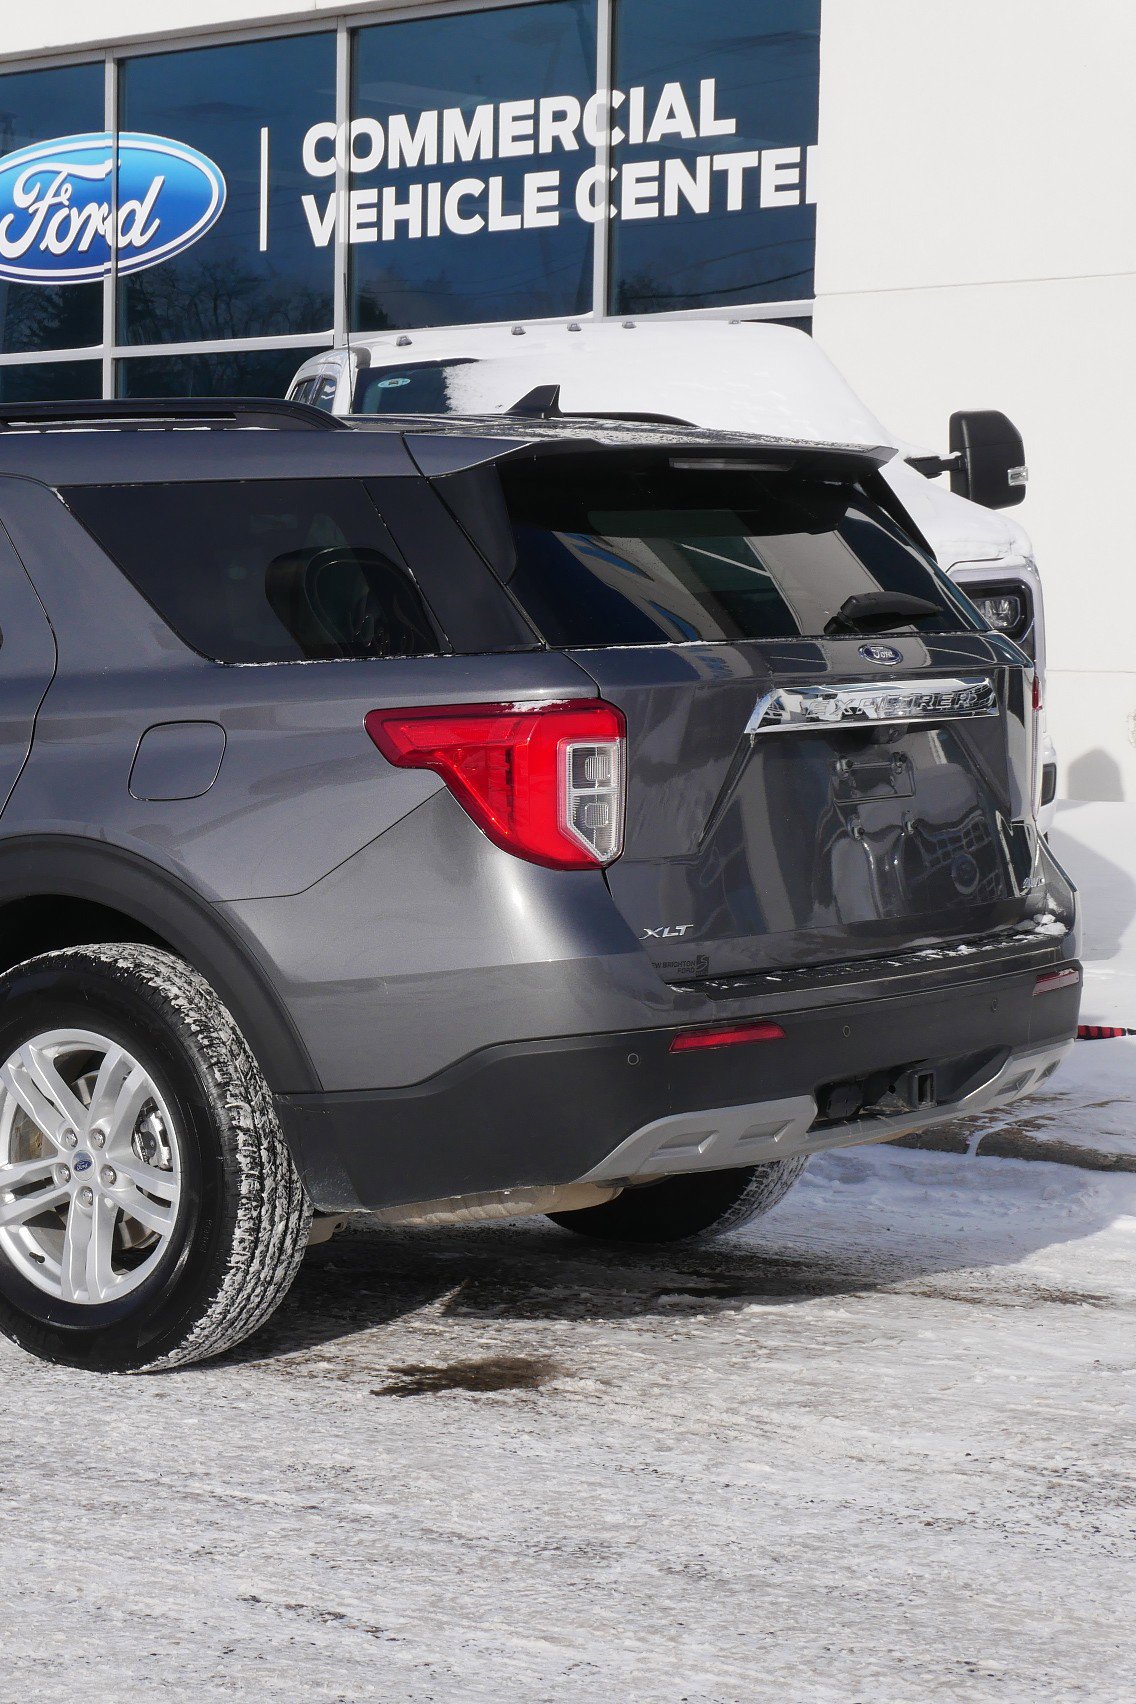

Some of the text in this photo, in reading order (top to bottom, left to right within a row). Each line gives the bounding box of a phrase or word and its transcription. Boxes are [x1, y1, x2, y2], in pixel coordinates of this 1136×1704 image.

[302, 78, 736, 178] COMMERCIAL
[301, 170, 560, 247] VEHICLE
[638, 924, 694, 940] XLT
[662, 960, 696, 969] BRIGHTON
